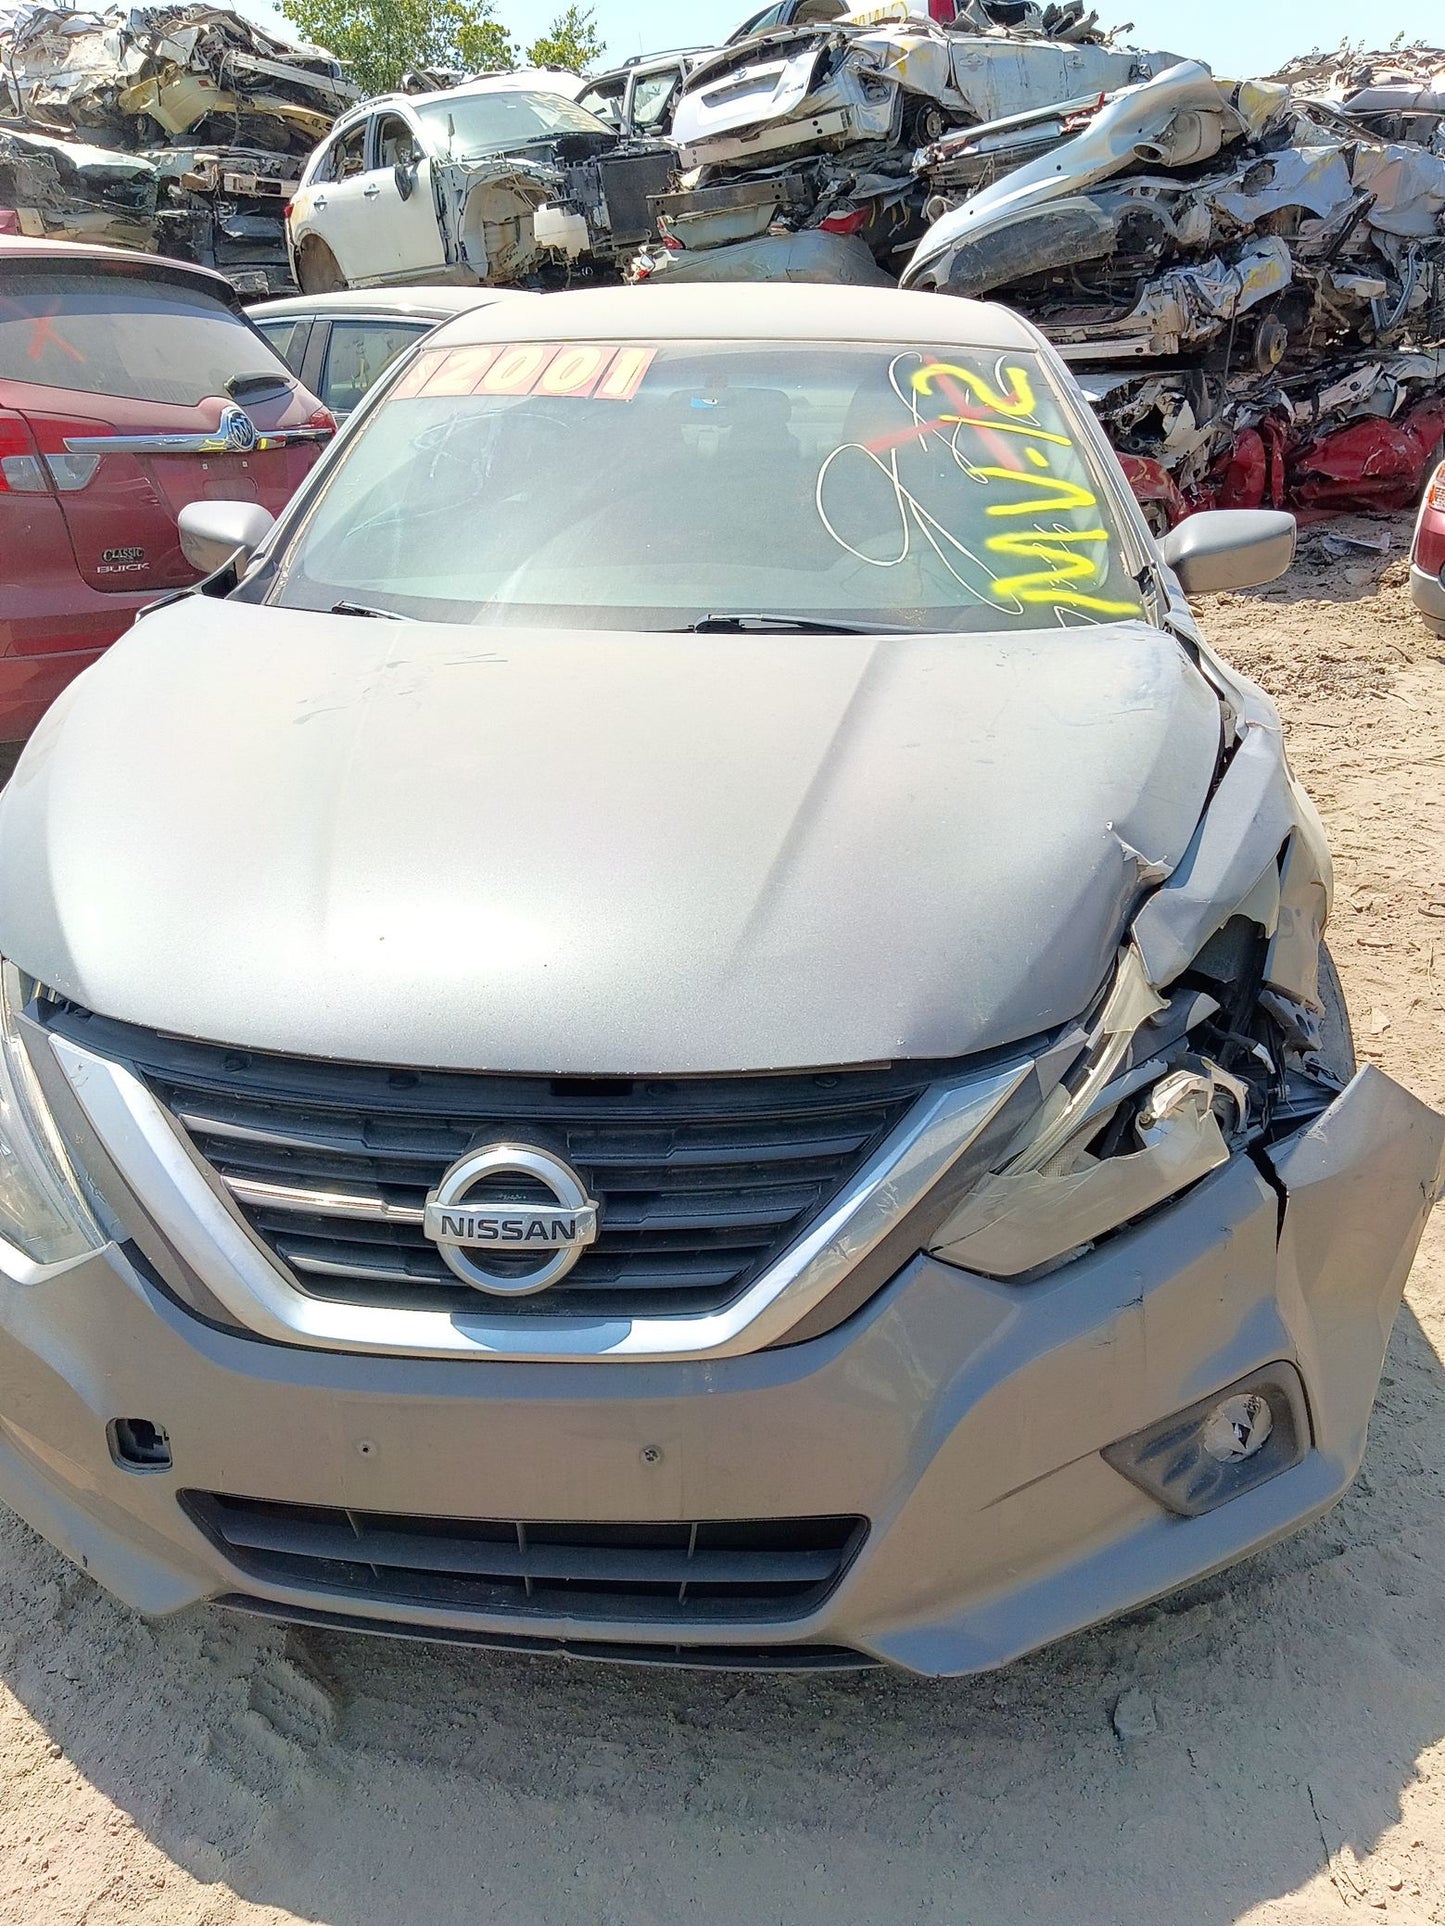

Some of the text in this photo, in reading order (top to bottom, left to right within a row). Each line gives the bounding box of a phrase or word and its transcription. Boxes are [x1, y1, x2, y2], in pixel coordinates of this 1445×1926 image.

[103, 547, 144, 561] CLASSIC
[96, 562, 150, 574] BUICK
[441, 1215, 576, 1241] NISSAN
